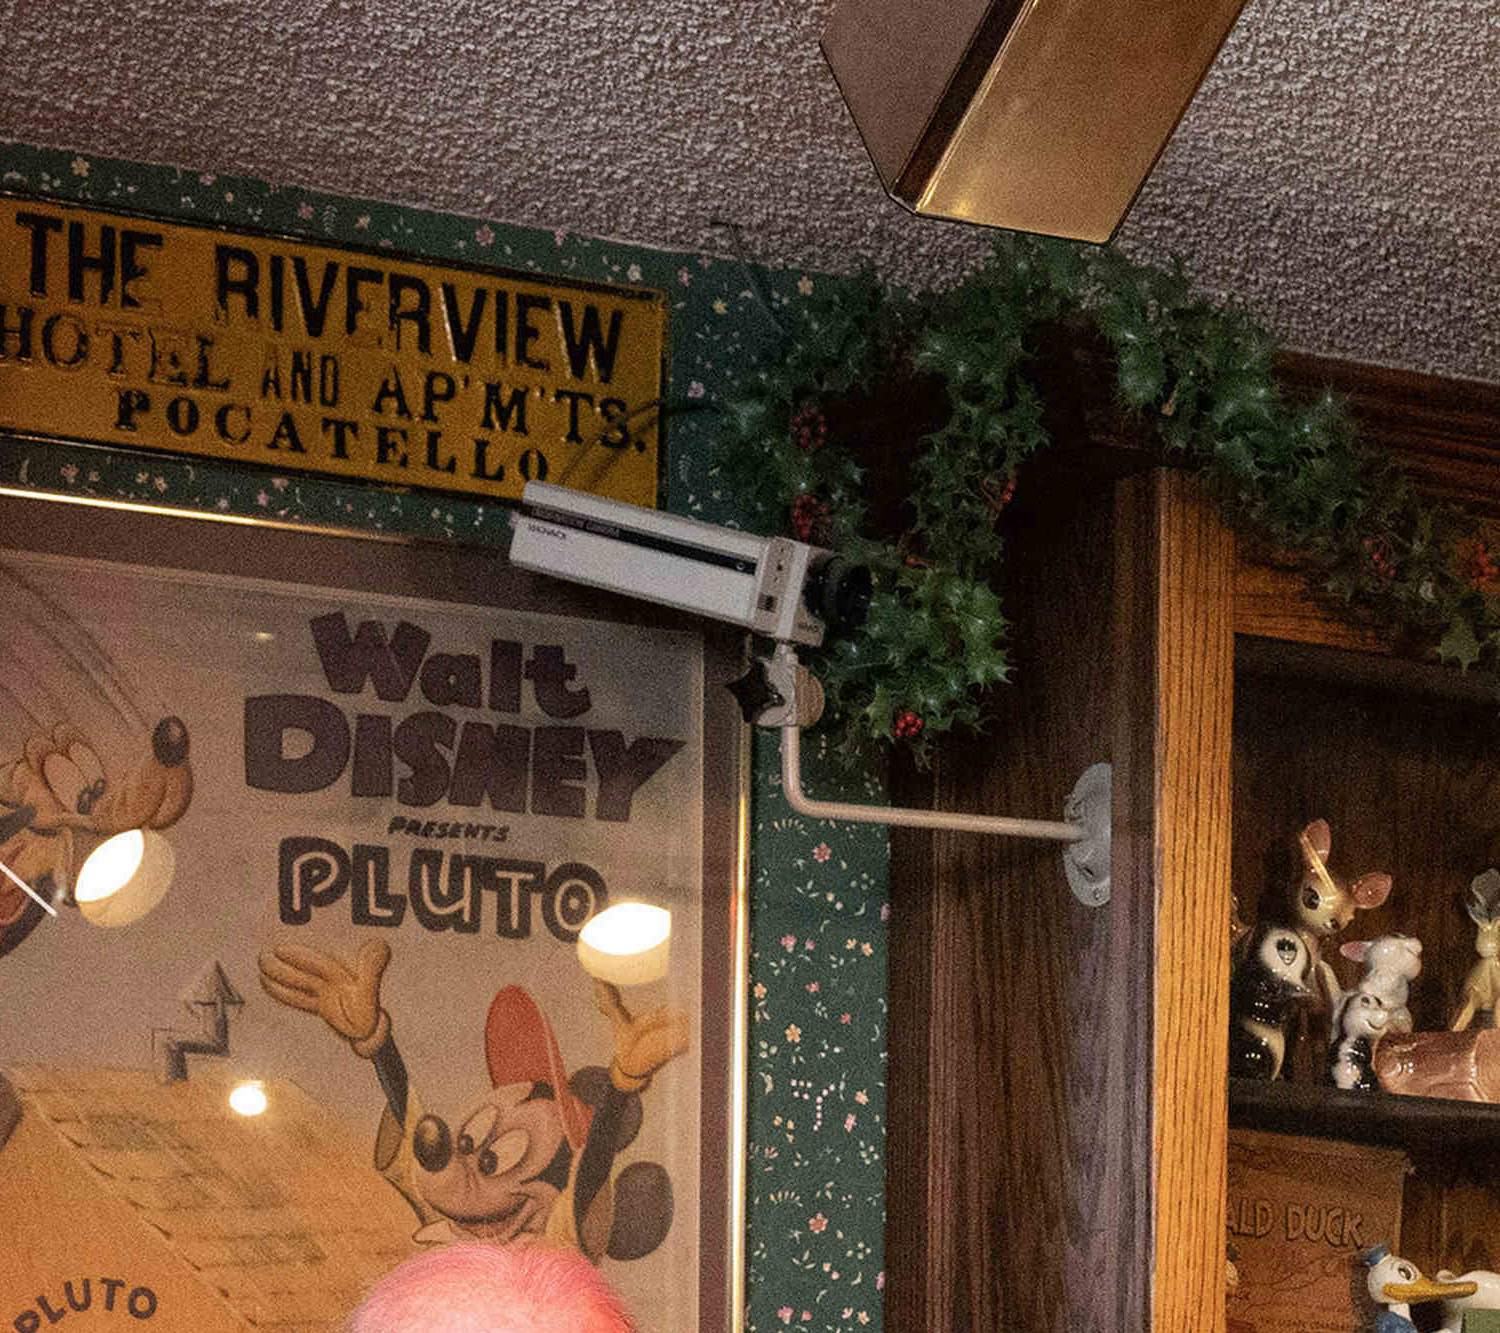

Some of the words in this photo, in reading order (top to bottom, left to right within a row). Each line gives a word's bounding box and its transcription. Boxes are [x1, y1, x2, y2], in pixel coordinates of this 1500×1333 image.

[16, 210, 163, 309] THE
[215, 245, 626, 386] RIVERVIEW
[261, 351, 341, 409] AND
[113, 388, 551, 484] POCATELLO
[309, 609, 592, 720] Walt
[241, 692, 687, 825] DISNEY
[385, 813, 511, 844] PRESENTS
[276, 835, 608, 946] PLUTO
[1284, 1201, 1365, 1249] DUCK
